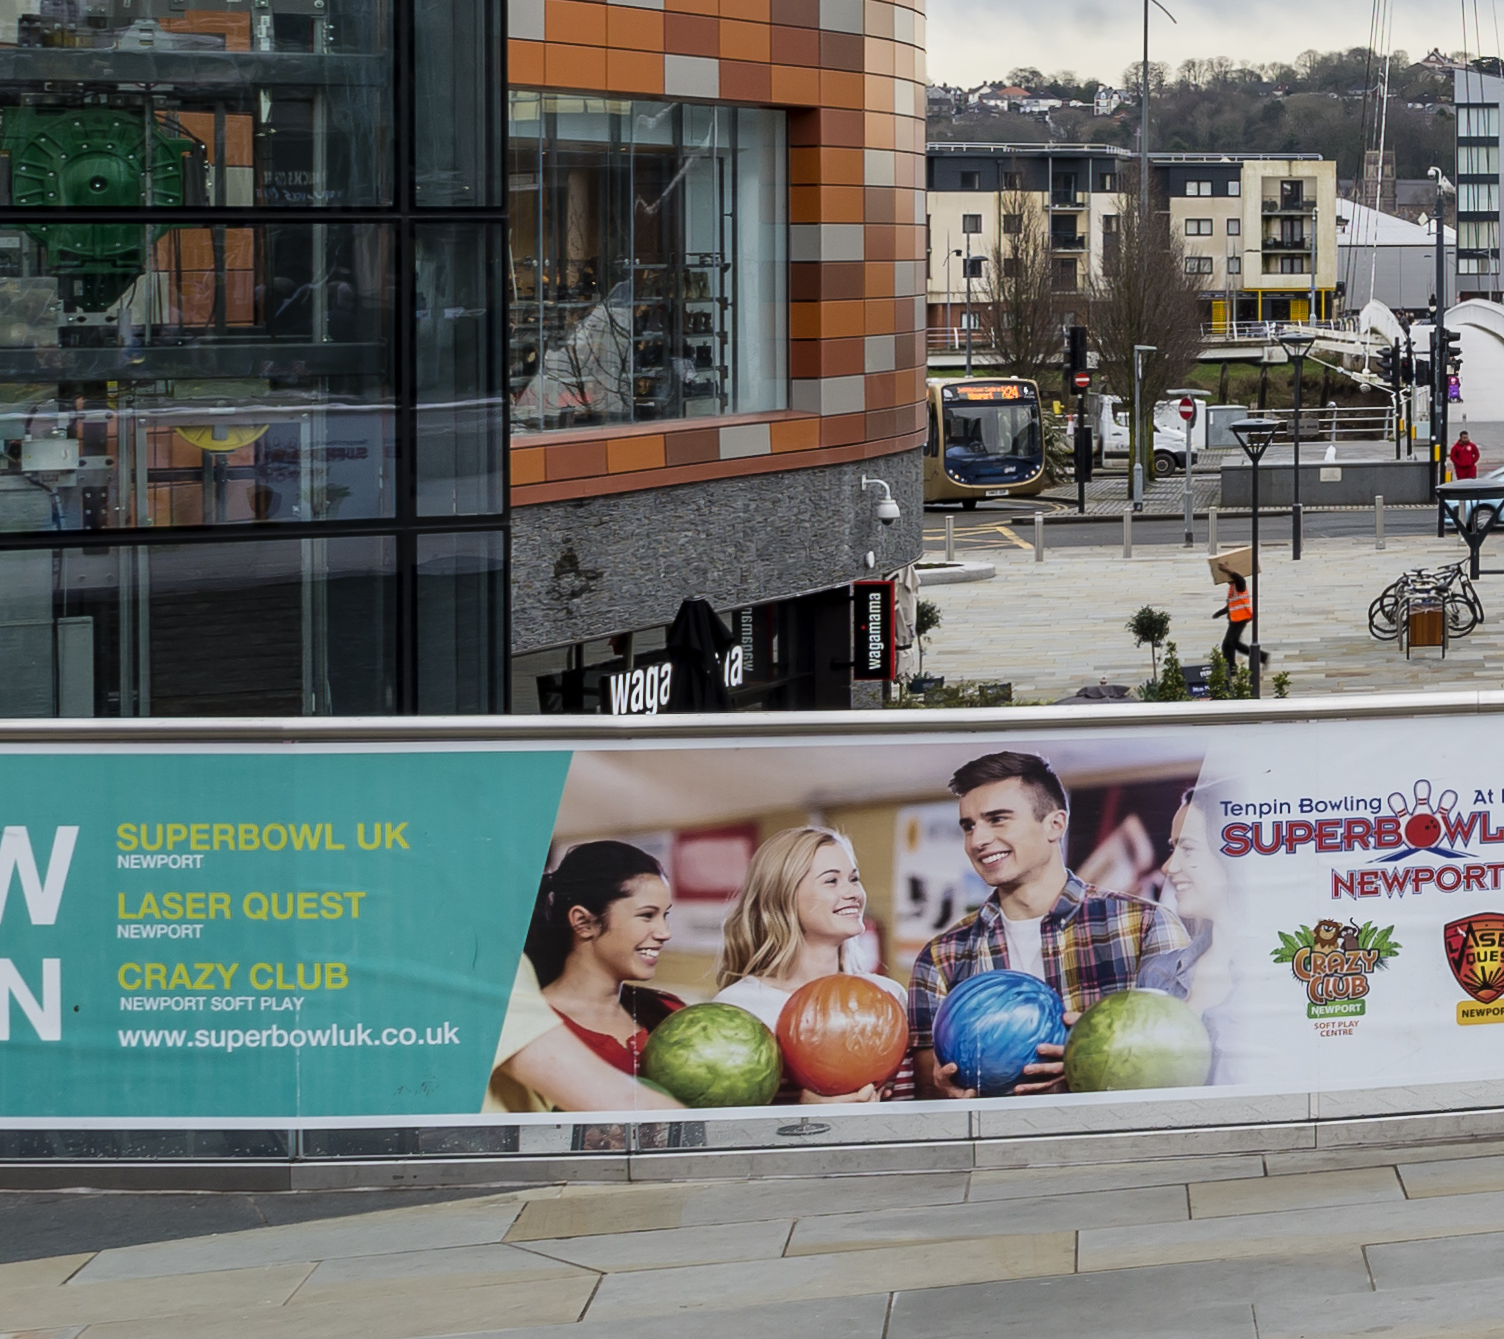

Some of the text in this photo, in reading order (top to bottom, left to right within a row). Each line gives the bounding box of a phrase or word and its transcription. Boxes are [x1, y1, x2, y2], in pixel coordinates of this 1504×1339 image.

[868, 592, 885, 671] wagamama
[1219, 795, 1382, 819] Tenpin Bowling
[1473, 788, 1494, 805] At
[117, 822, 410, 852] SUPERBOWL UK
[117, 854, 204, 869] NEWPORT
[118, 891, 366, 921] LASER QUEST
[117, 924, 203, 939] NEWPORT
[1292, 946, 1380, 982] CRAZY
[118, 962, 350, 991] CRAZY CLUB
[1307, 973, 1370, 1004] CLUB
[120, 995, 305, 1011] NEWPORT SOFT PLAY
[1311, 1003, 1362, 1015] NEWPORT
[1314, 1019, 1360, 1030] SOFT PLAY
[1320, 1028, 1354, 1038] CENTRE
[118, 1022, 461, 1052] www.superbowluk.co.uk
